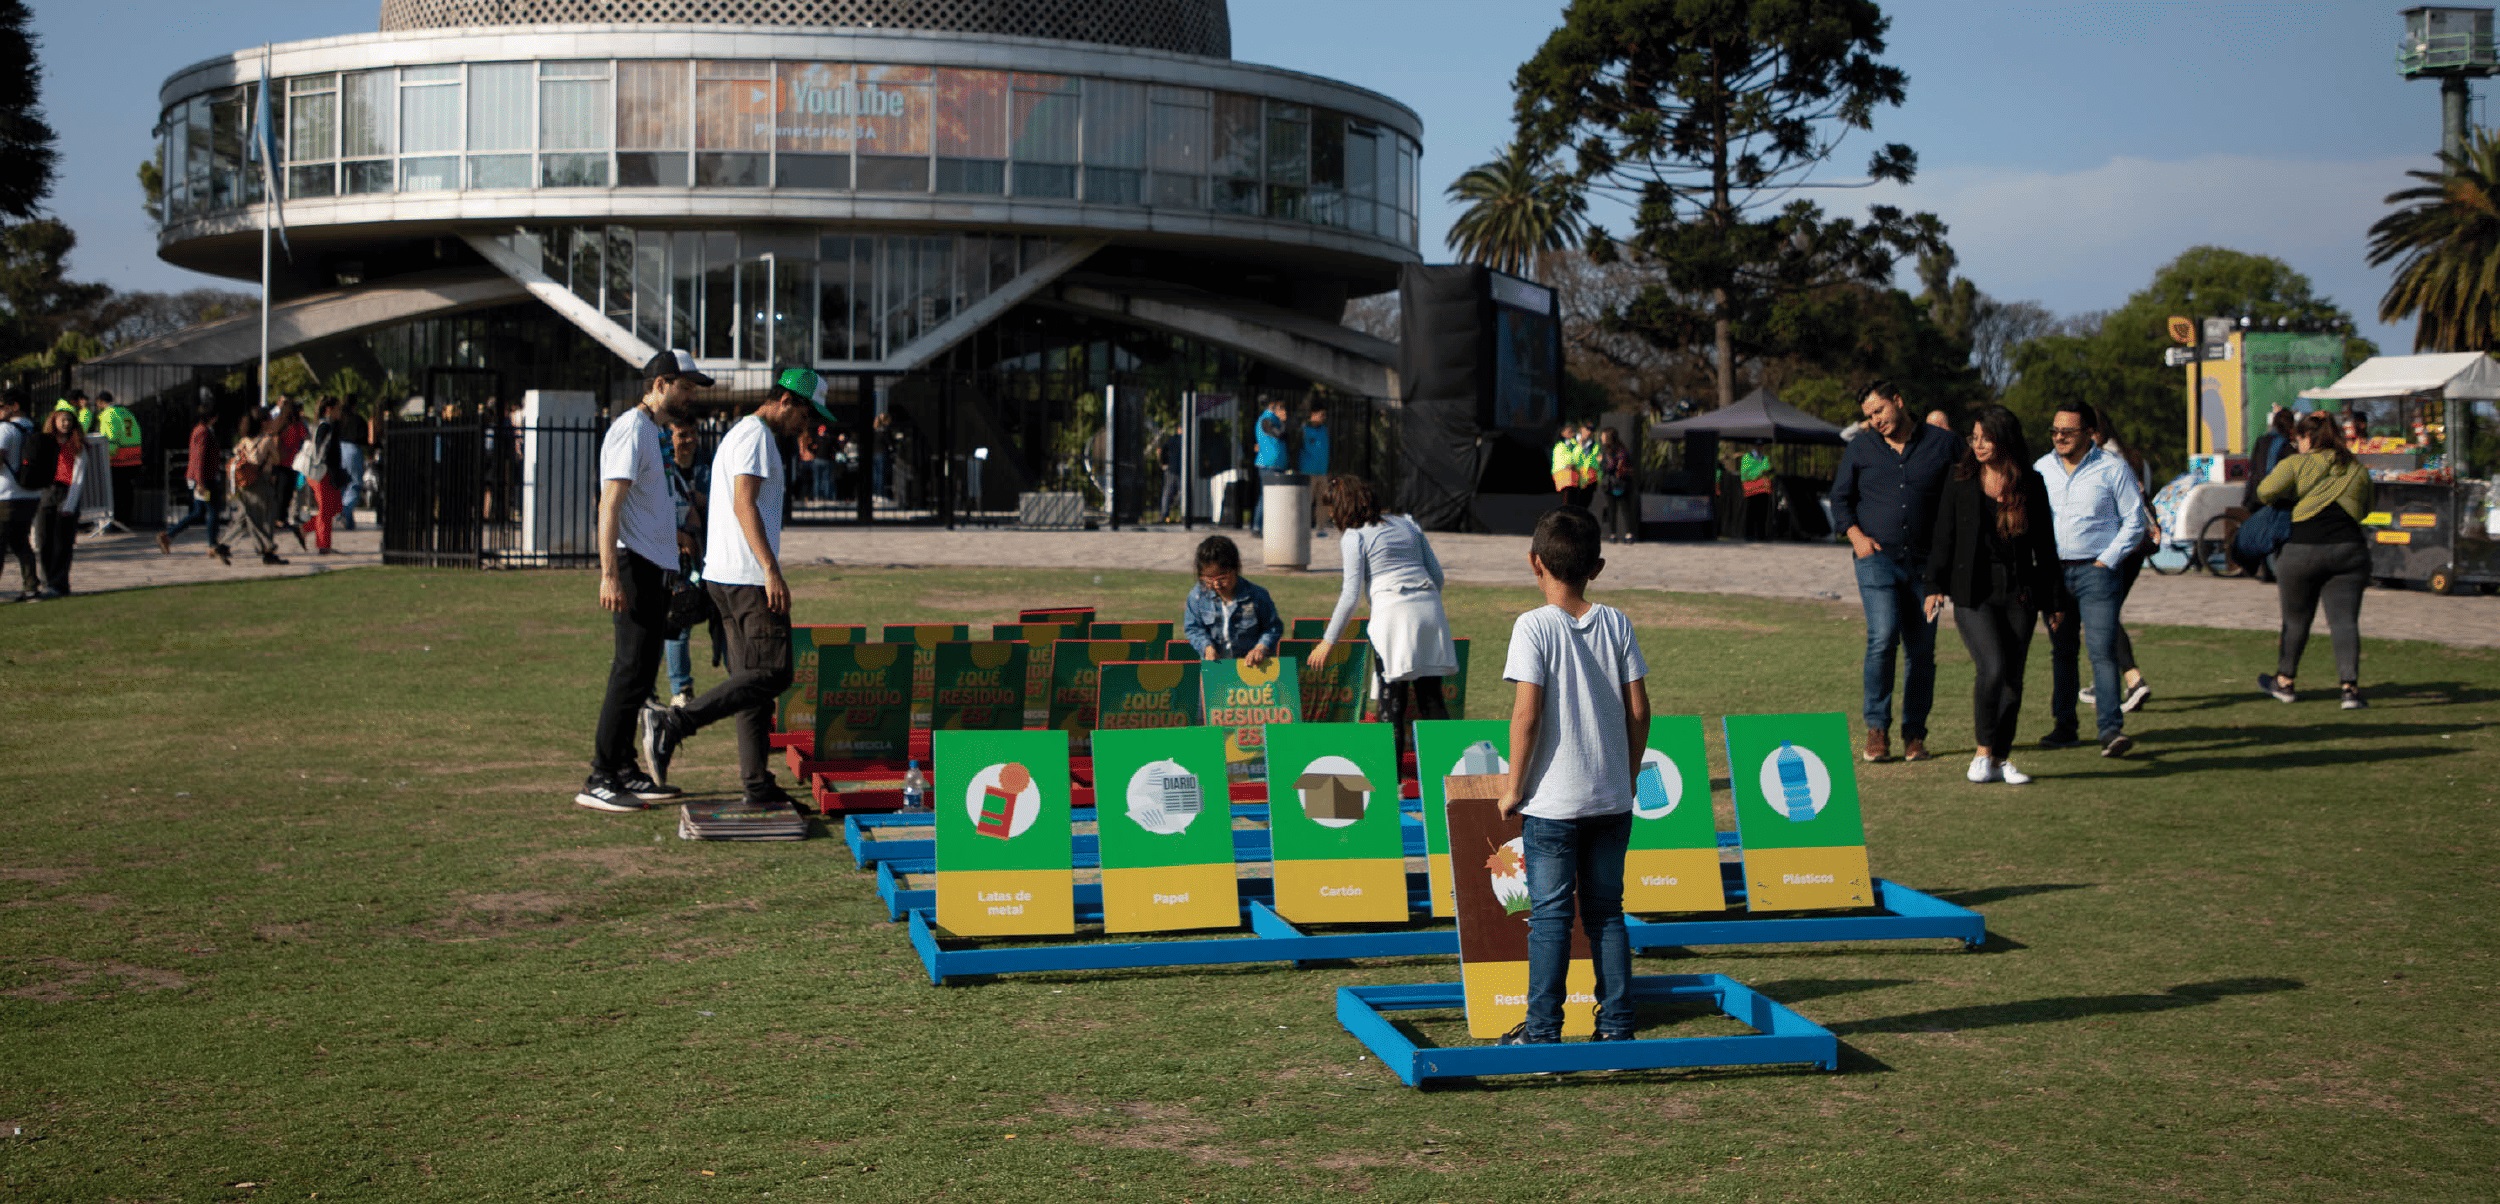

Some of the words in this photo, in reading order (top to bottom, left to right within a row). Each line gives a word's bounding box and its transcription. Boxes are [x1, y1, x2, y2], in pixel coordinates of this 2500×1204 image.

[792, 81, 905, 117] YouTube
[840, 669, 887, 689] ¿QUÉ
[957, 666, 1001, 687] ¿QUÉ
[822, 690, 903, 706] RESIDUO
[939, 688, 1016, 705] RESIDUO
[1122, 689, 1172, 711] ¿QUÉ
[1227, 684, 1275, 707] ¿QUÉ
[1103, 711, 1187, 730] RESIDUO
[1210, 707, 1293, 727] RESIDUO
[1237, 728, 1262, 746] ES
[1163, 777, 1196, 790] DIARIO
[1640, 875, 1678, 886] Vidrio
[1782, 873, 1835, 885] Plásticos
[978, 890, 1012, 902] Latas
[1015, 890, 1032, 902] de
[1153, 892, 1189, 905] Papel
[1319, 885, 1363, 897] Cartón
[987, 904, 1024, 916] metal
[1494, 994, 1529, 1006] Rest
[1565, 991, 1598, 1004] rdes
